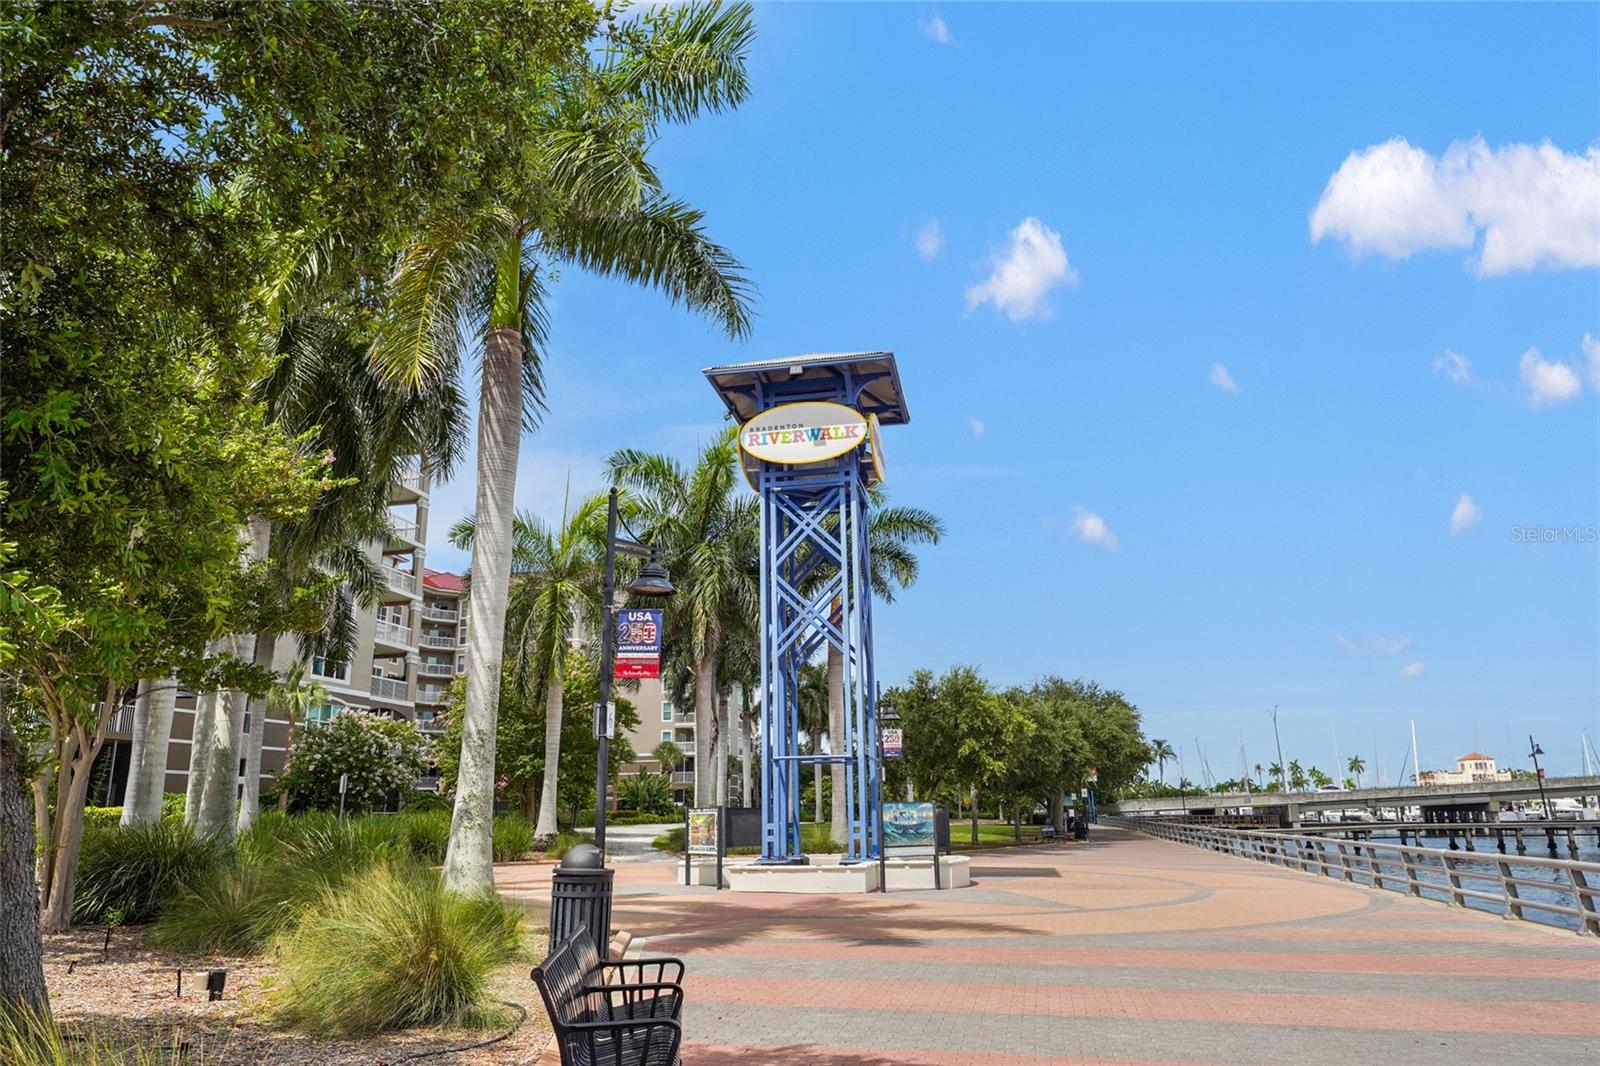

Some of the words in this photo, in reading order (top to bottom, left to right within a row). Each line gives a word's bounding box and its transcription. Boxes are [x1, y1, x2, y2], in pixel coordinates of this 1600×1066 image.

[748, 424, 859, 446] RIVERWALK
[750, 423, 804, 432] BRADENTON
[628, 611, 653, 621] USA
[618, 622, 657, 643] 250
